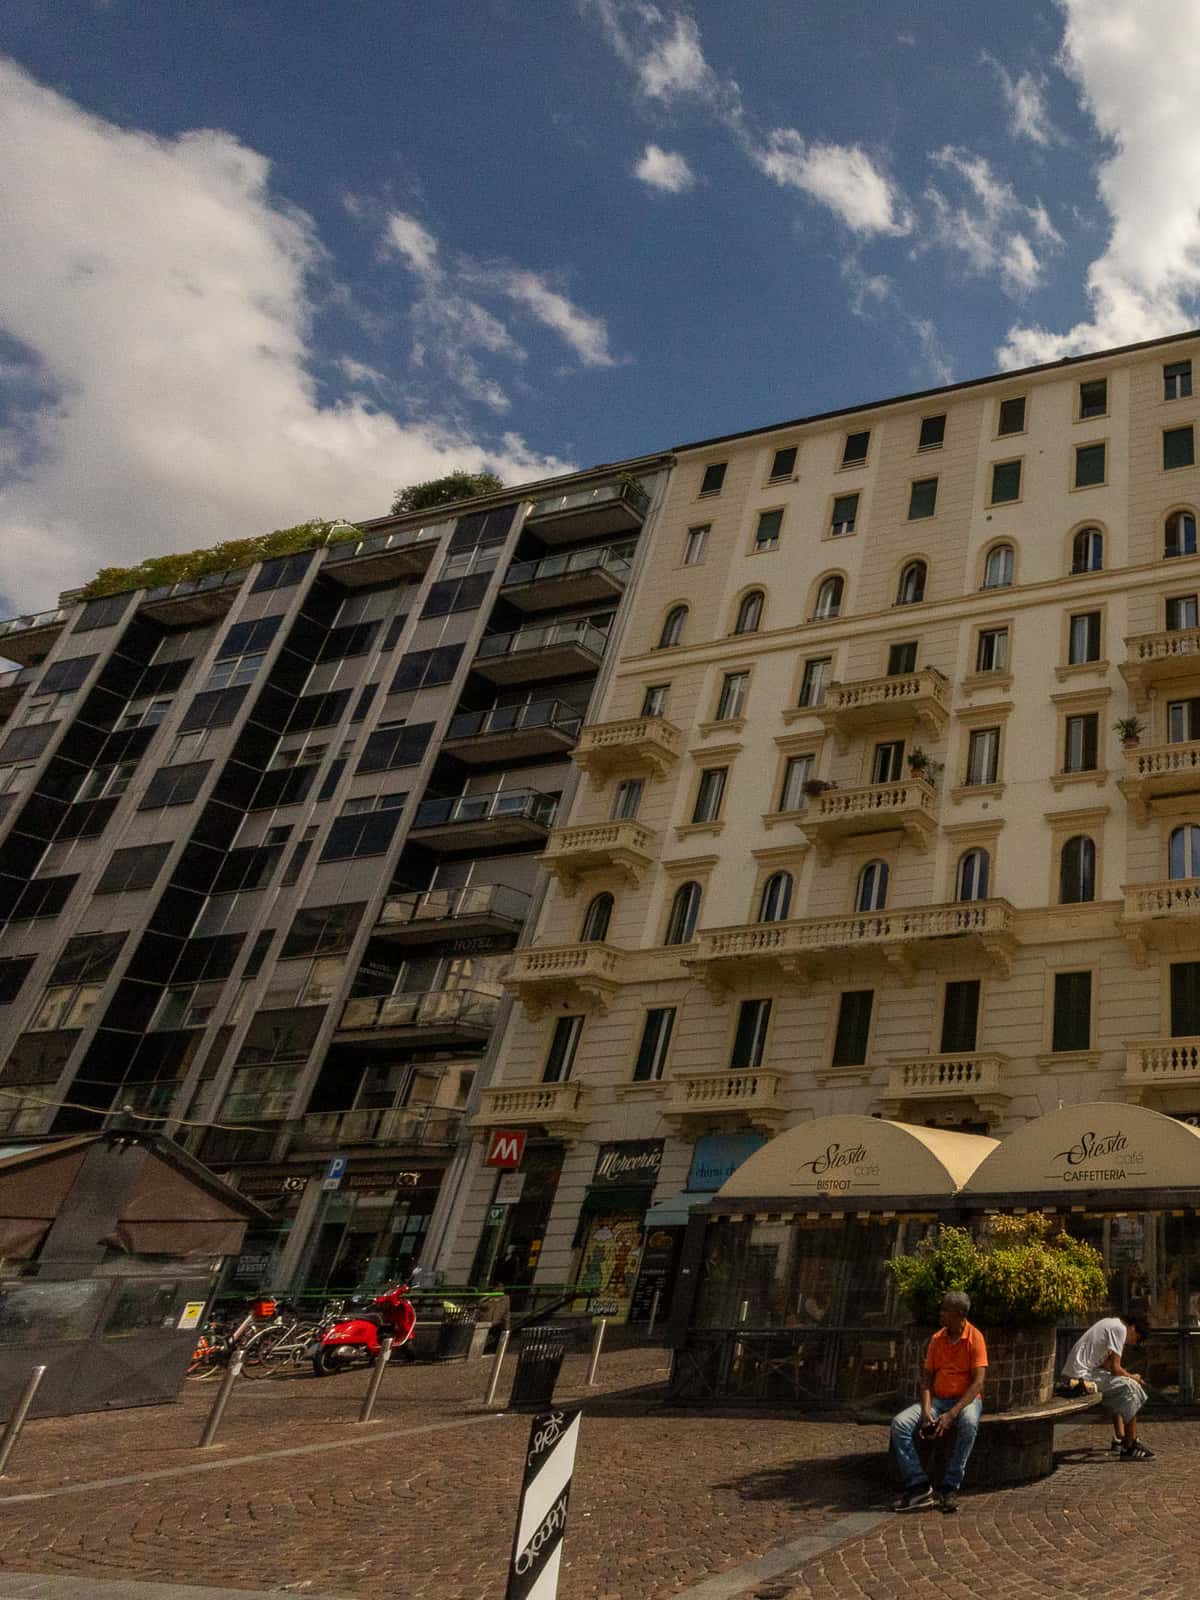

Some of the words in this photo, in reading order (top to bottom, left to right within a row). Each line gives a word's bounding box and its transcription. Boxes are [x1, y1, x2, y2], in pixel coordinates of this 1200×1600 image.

[491, 1137, 517, 1161] M
[1052, 1130, 1128, 1165] Siesta
[330, 1158, 344, 1177] P
[799, 1143, 867, 1175] Siesta
[816, 1179, 851, 1191] BISTROT
[1063, 1168, 1126, 1183] CAFFETTERIA
